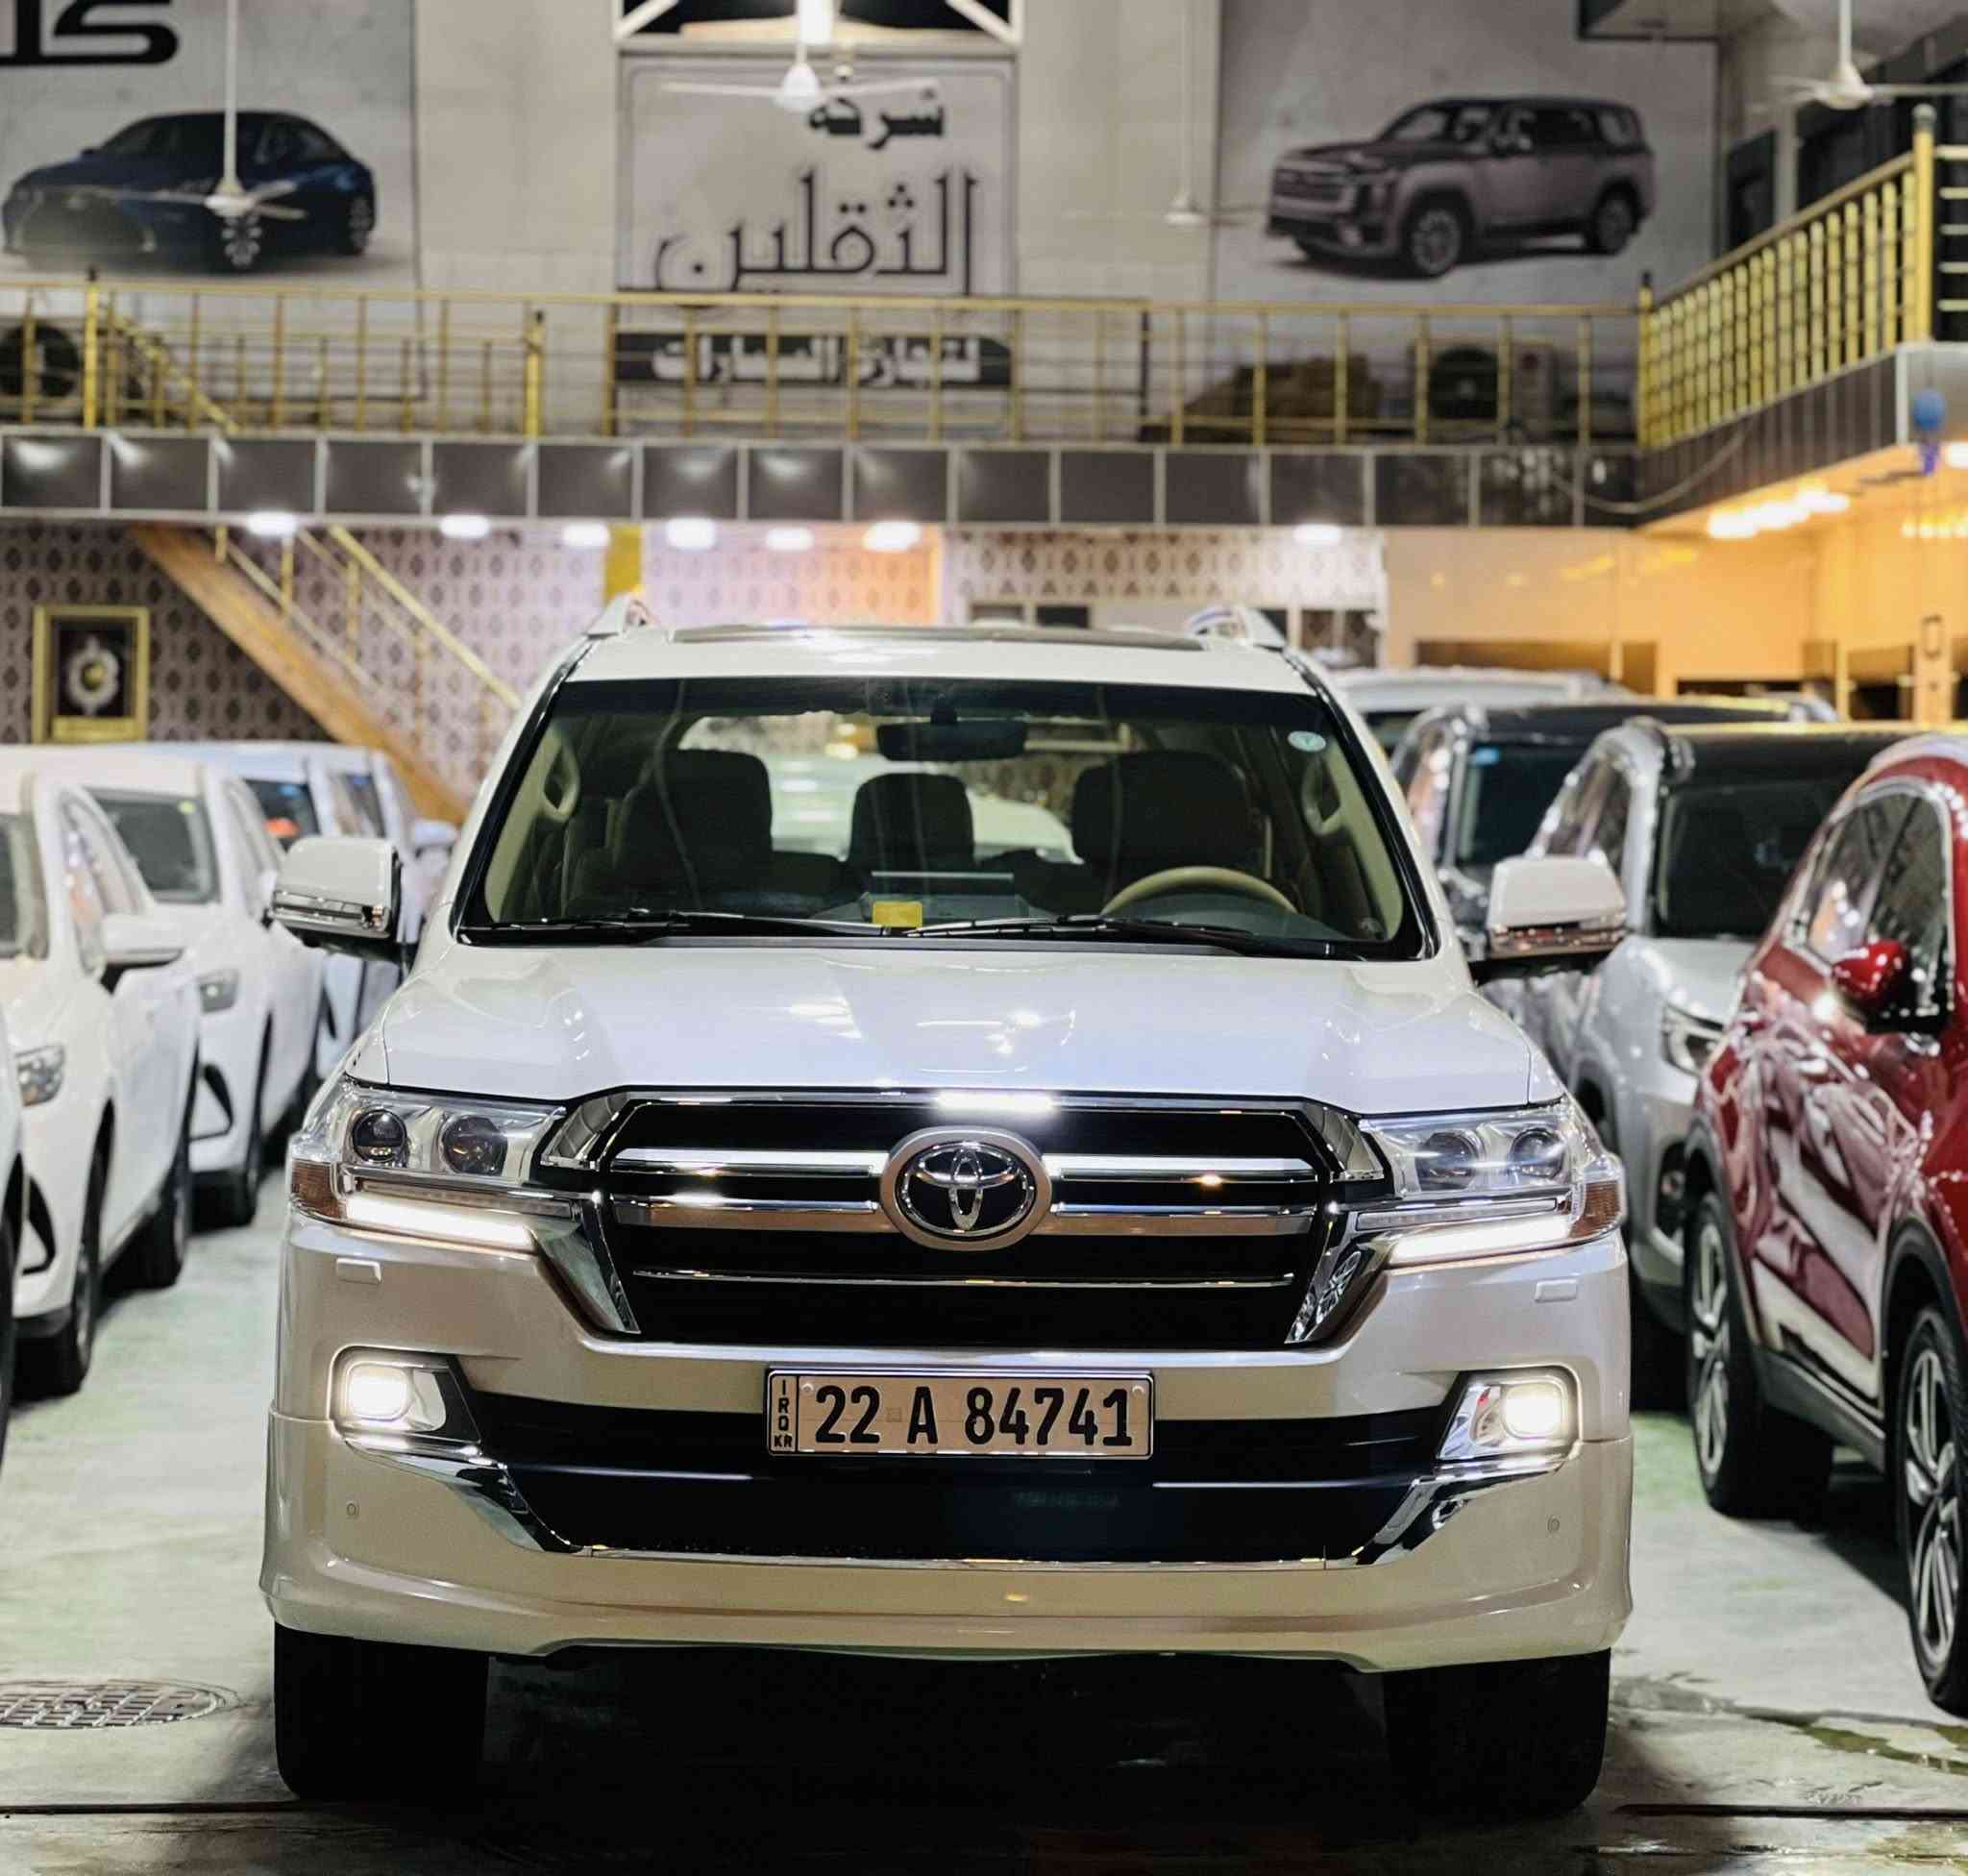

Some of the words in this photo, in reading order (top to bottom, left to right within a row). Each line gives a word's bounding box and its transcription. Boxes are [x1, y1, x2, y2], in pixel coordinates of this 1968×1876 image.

[655, 170, 978, 306] الثقلين
[815, 1385, 881, 1444] 22
[906, 1386, 939, 1444] A
[964, 1387, 1133, 1446] 84741
